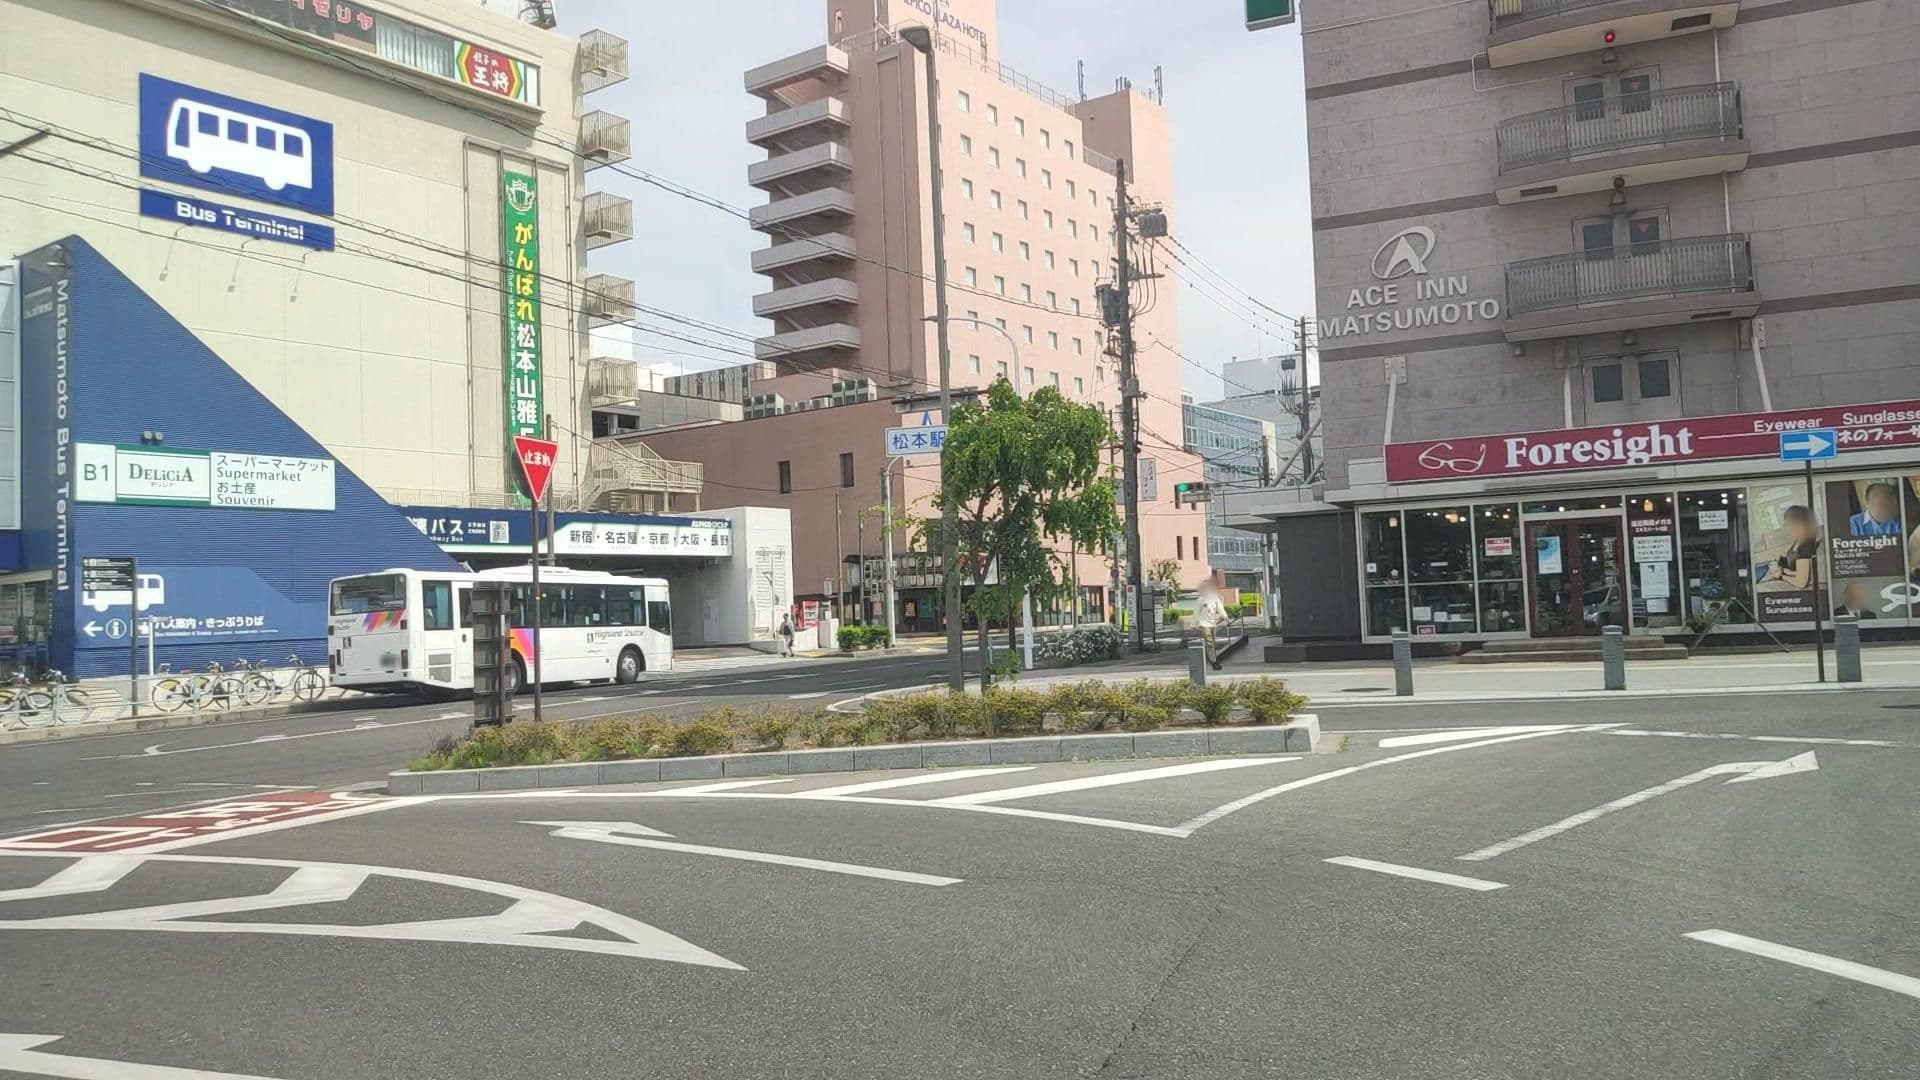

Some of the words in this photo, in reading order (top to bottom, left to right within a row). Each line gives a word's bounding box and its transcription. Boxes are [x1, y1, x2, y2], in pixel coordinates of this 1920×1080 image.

[962, 22, 988, 48] HOTEL
[473, 64, 509, 93] 王将
[177, 201, 216, 222] Bus
[222, 209, 304, 240] Terminal
[1346, 284, 1399, 309] ACE
[1416, 275, 1468, 300] INN
[1318, 298, 1500, 339] MATSUMOTO
[56, 279, 69, 420] Matsumoto
[1753, 417, 1823, 433] Eyewear
[56, 427, 70, 476] Bus
[1503, 424, 1694, 468] Foresight
[216, 455, 330, 472] スーパーマーケット
[524, 449, 551, 467] 止まれ
[83, 463, 110, 483] B1
[216, 467, 302, 483] Supermarket
[216, 481, 257, 495] お土産
[216, 494, 276, 506] Souvenir
[56, 481, 70, 592] Terminal
[1831, 535, 1897, 550] Foresight
[1765, 597, 1802, 606] Eyewear
[1765, 606, 1813, 614] Sunglasses
